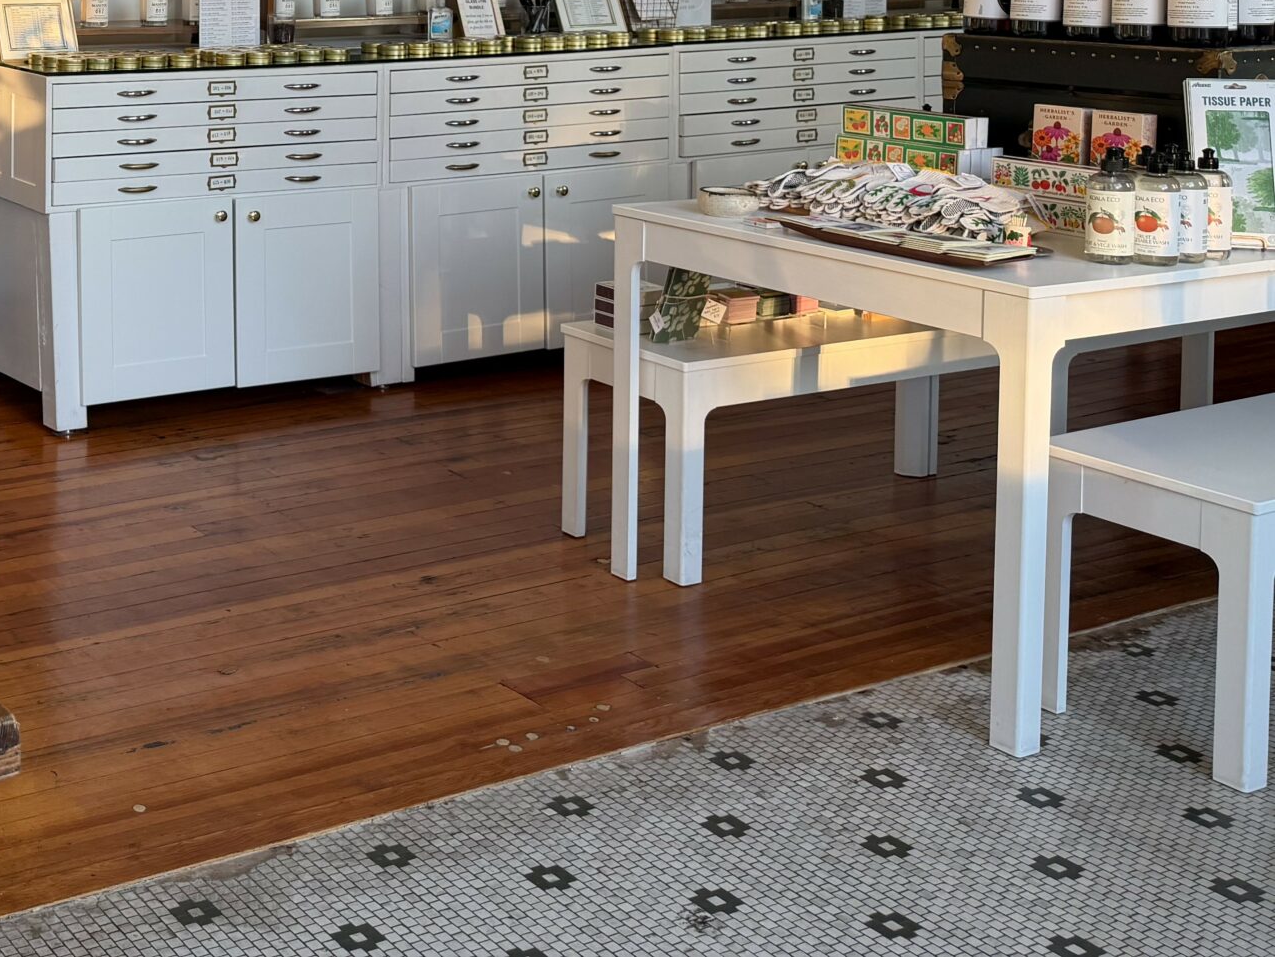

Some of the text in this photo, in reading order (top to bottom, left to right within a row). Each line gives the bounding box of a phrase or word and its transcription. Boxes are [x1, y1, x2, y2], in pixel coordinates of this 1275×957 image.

[1202, 96, 1271, 107] TISSUE PAPER
[1040, 108, 1075, 116] HERBALIST'S
[1099, 114, 1136, 122] HERBALIST'S
